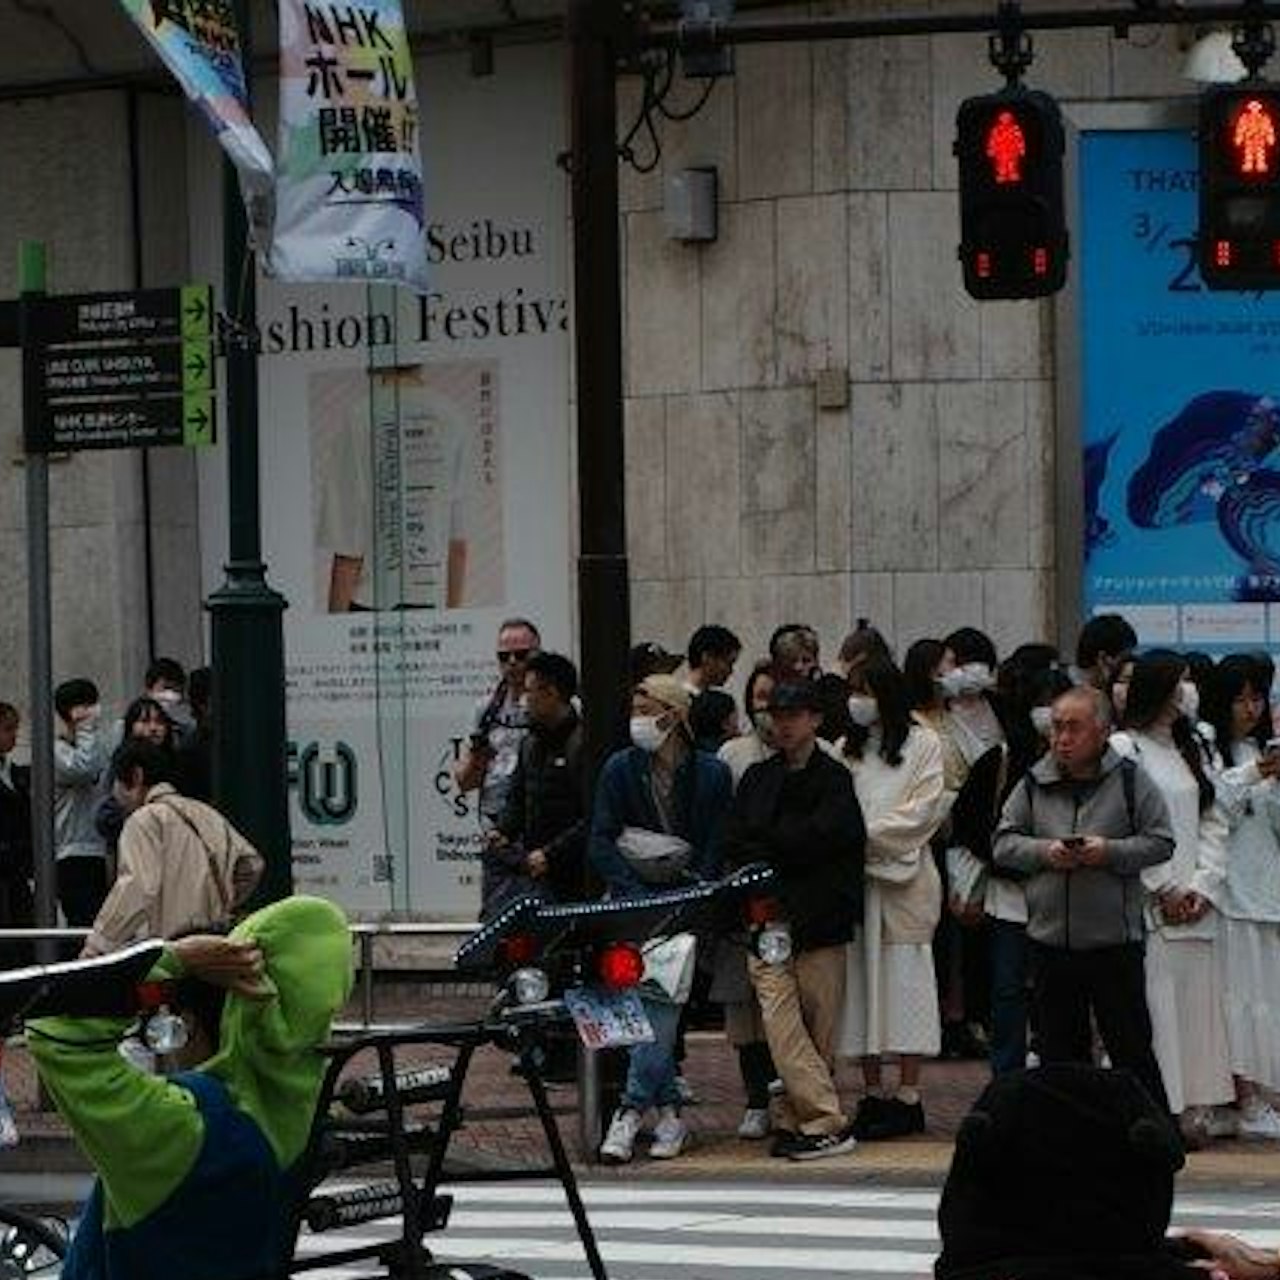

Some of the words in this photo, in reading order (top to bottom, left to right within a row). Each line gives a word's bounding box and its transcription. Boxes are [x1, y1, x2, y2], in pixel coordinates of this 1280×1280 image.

[304, 3, 393, 50] NHK
[304, 51, 407, 100] ホール
[426, 219, 533, 263] Seibu
